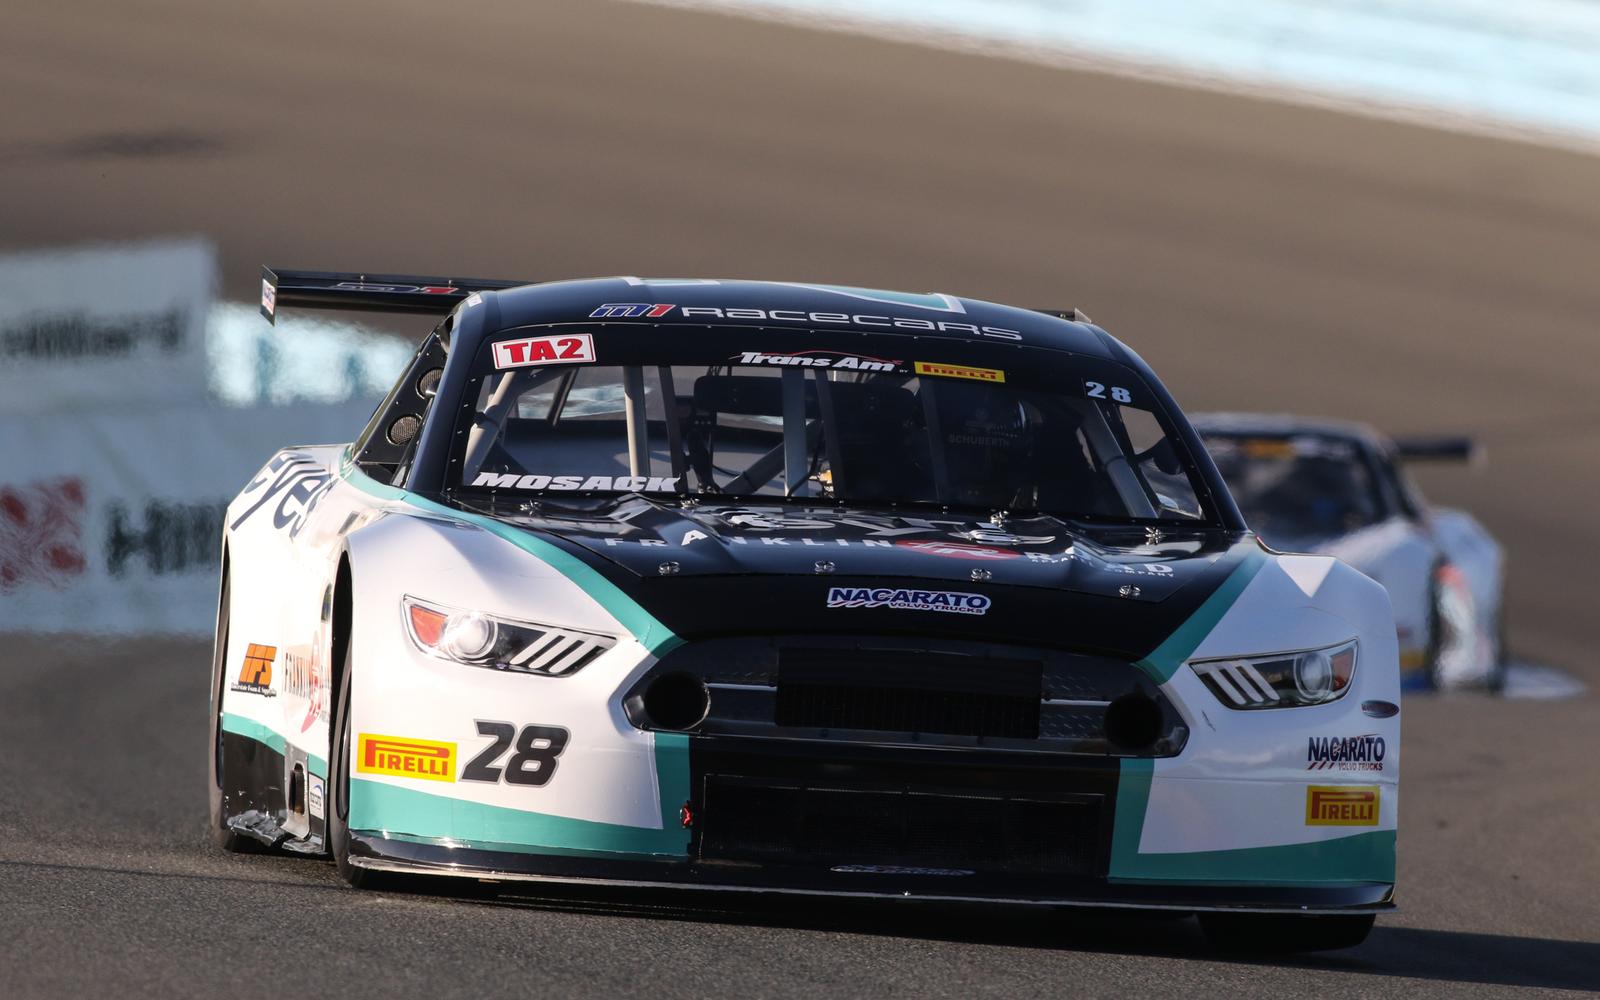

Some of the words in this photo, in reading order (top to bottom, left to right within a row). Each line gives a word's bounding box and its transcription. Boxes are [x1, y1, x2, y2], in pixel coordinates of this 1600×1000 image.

[502, 337, 585, 363] TA2
[740, 351, 833, 367] Trans
[832, 356, 896, 372] Am
[921, 364, 998, 380] PIRELLI
[1085, 381, 1132, 403] 28
[470, 471, 682, 493] MOSACK
[831, 588, 987, 609] NACARATO
[890, 602, 930, 610] VOLVO
[932, 604, 984, 614] TRUCKS
[364, 738, 451, 777] PIRELLI
[458, 718, 572, 788] 28
[1307, 736, 1386, 762] NACARATO
[1338, 762, 1357, 772] VOLVO
[1358, 762, 1384, 772] TRUCKS
[1311, 791, 1376, 821] PIRELLI
